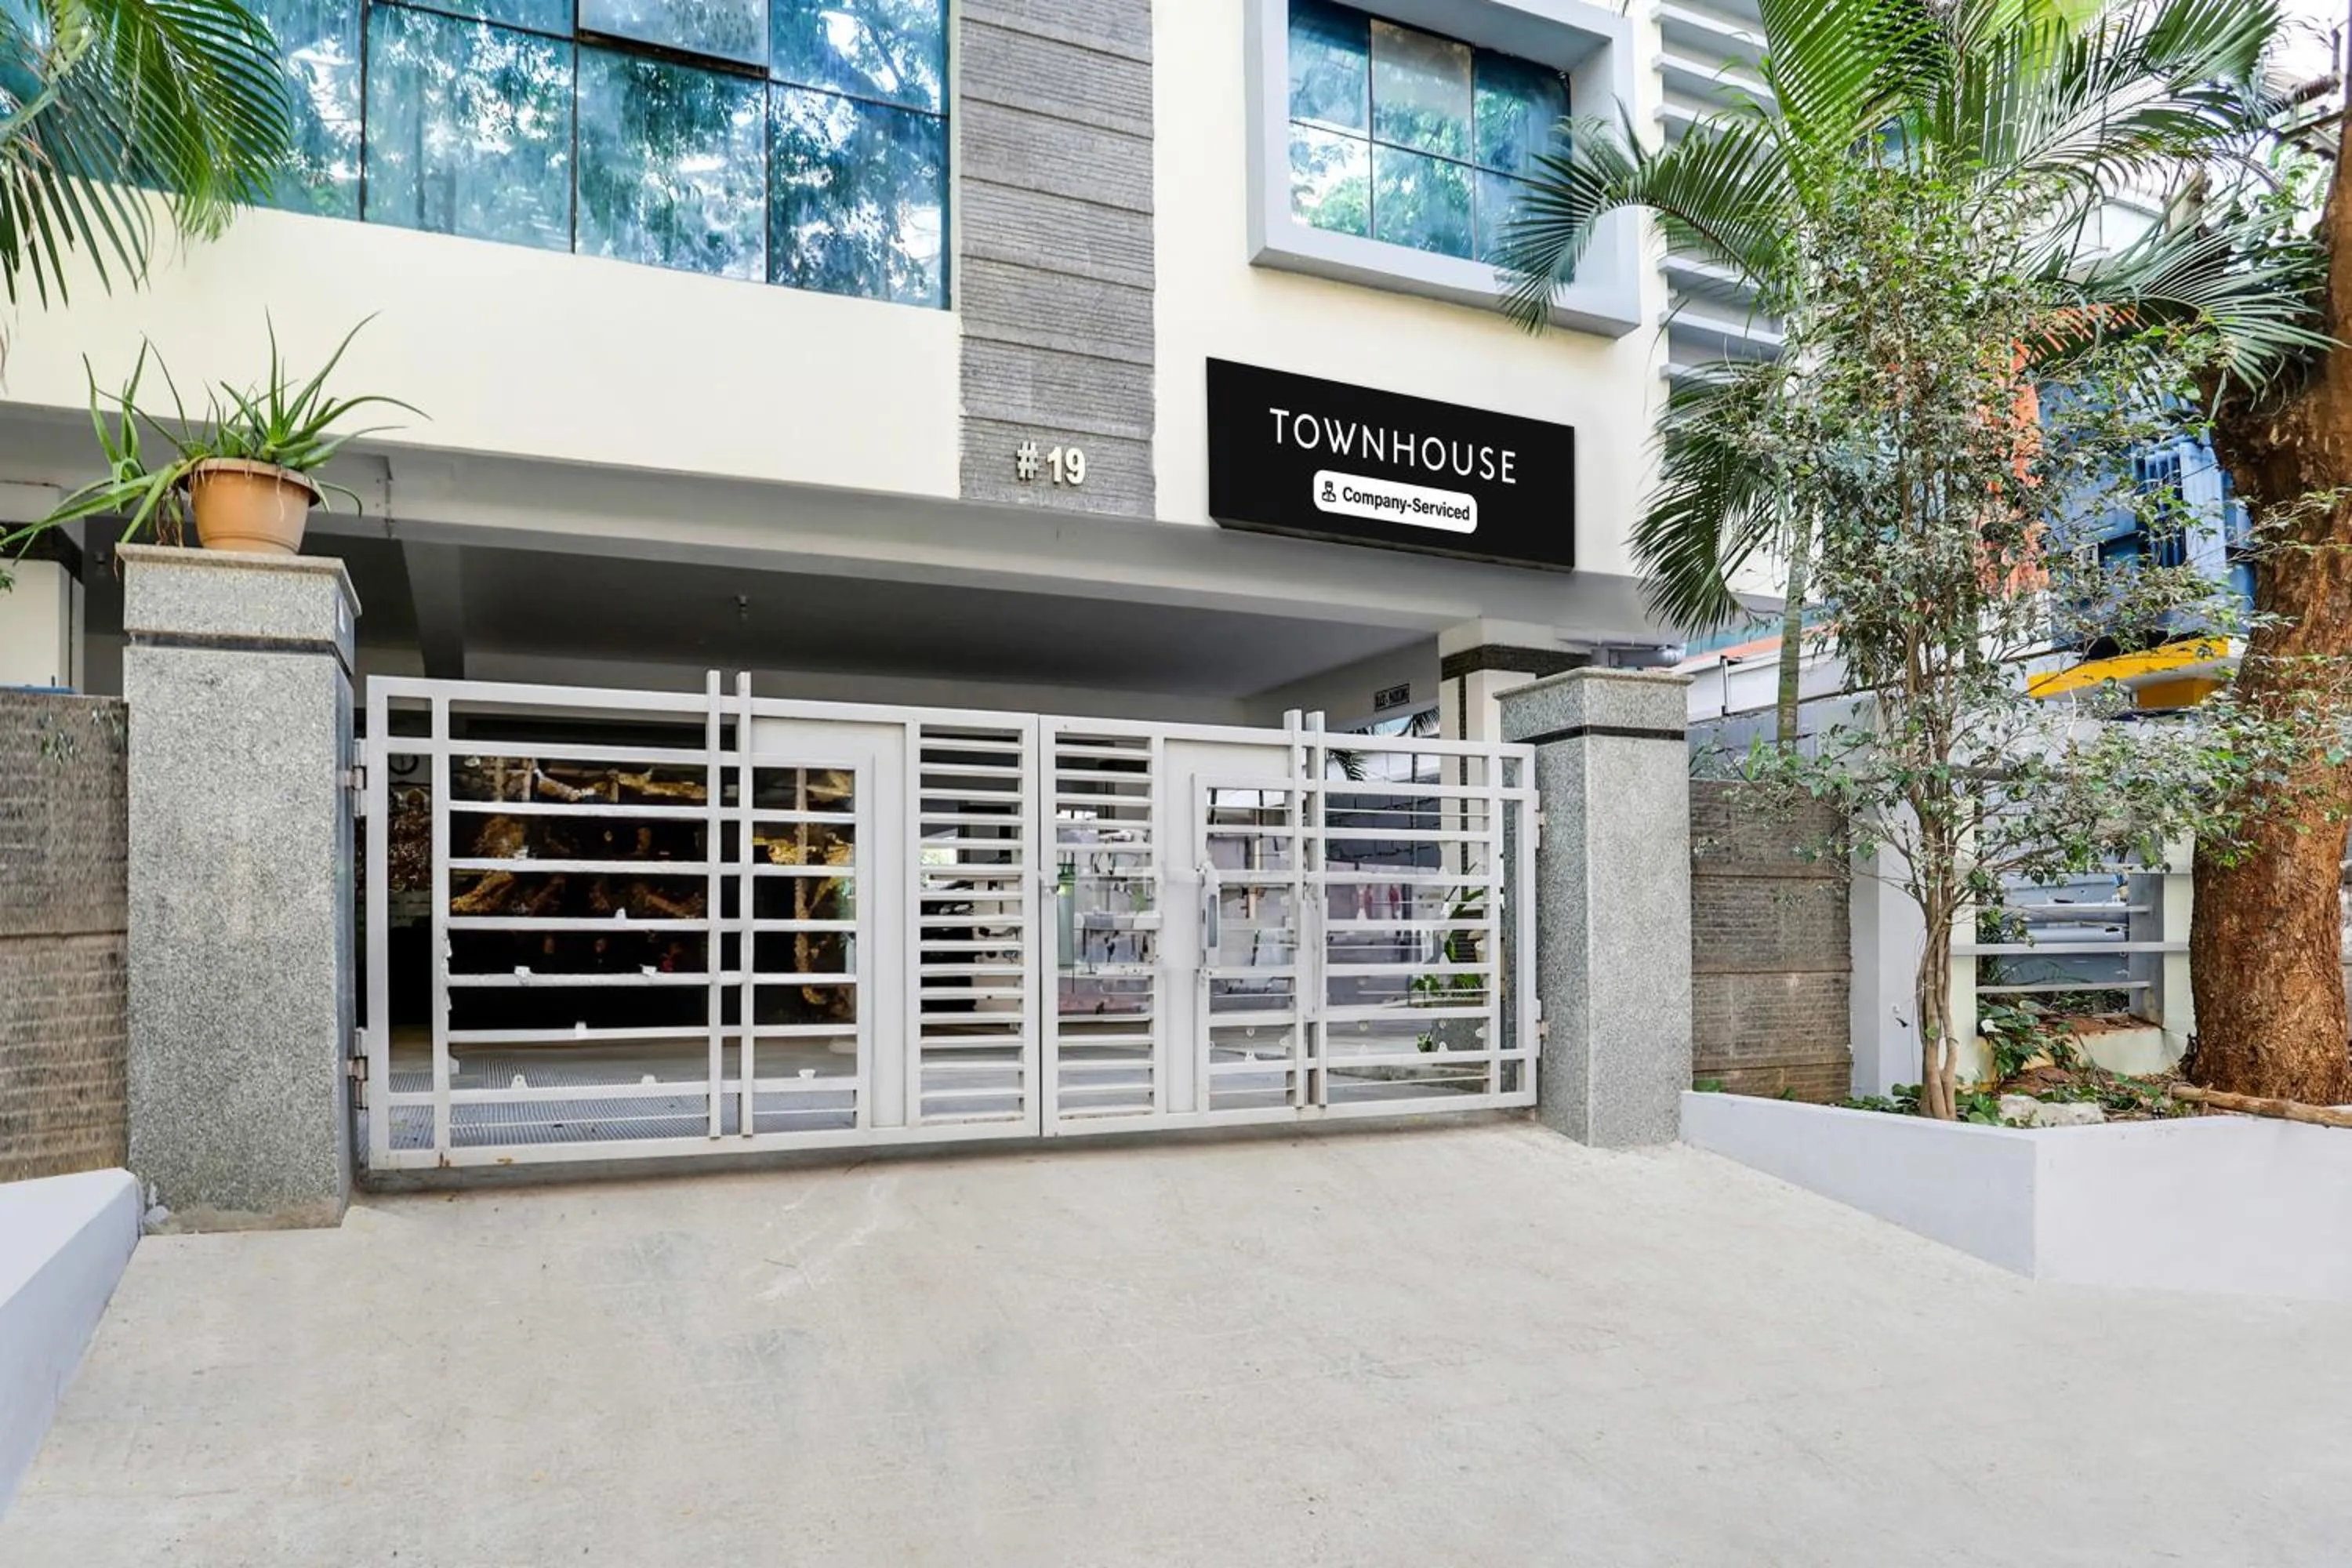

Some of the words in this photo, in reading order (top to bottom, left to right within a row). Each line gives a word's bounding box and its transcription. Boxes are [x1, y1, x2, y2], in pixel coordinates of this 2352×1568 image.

[1047, 446, 1086, 485] 19
[1269, 408, 1516, 484] TOWNHOUSE
[1342, 486, 1470, 521] Company-Serviced
